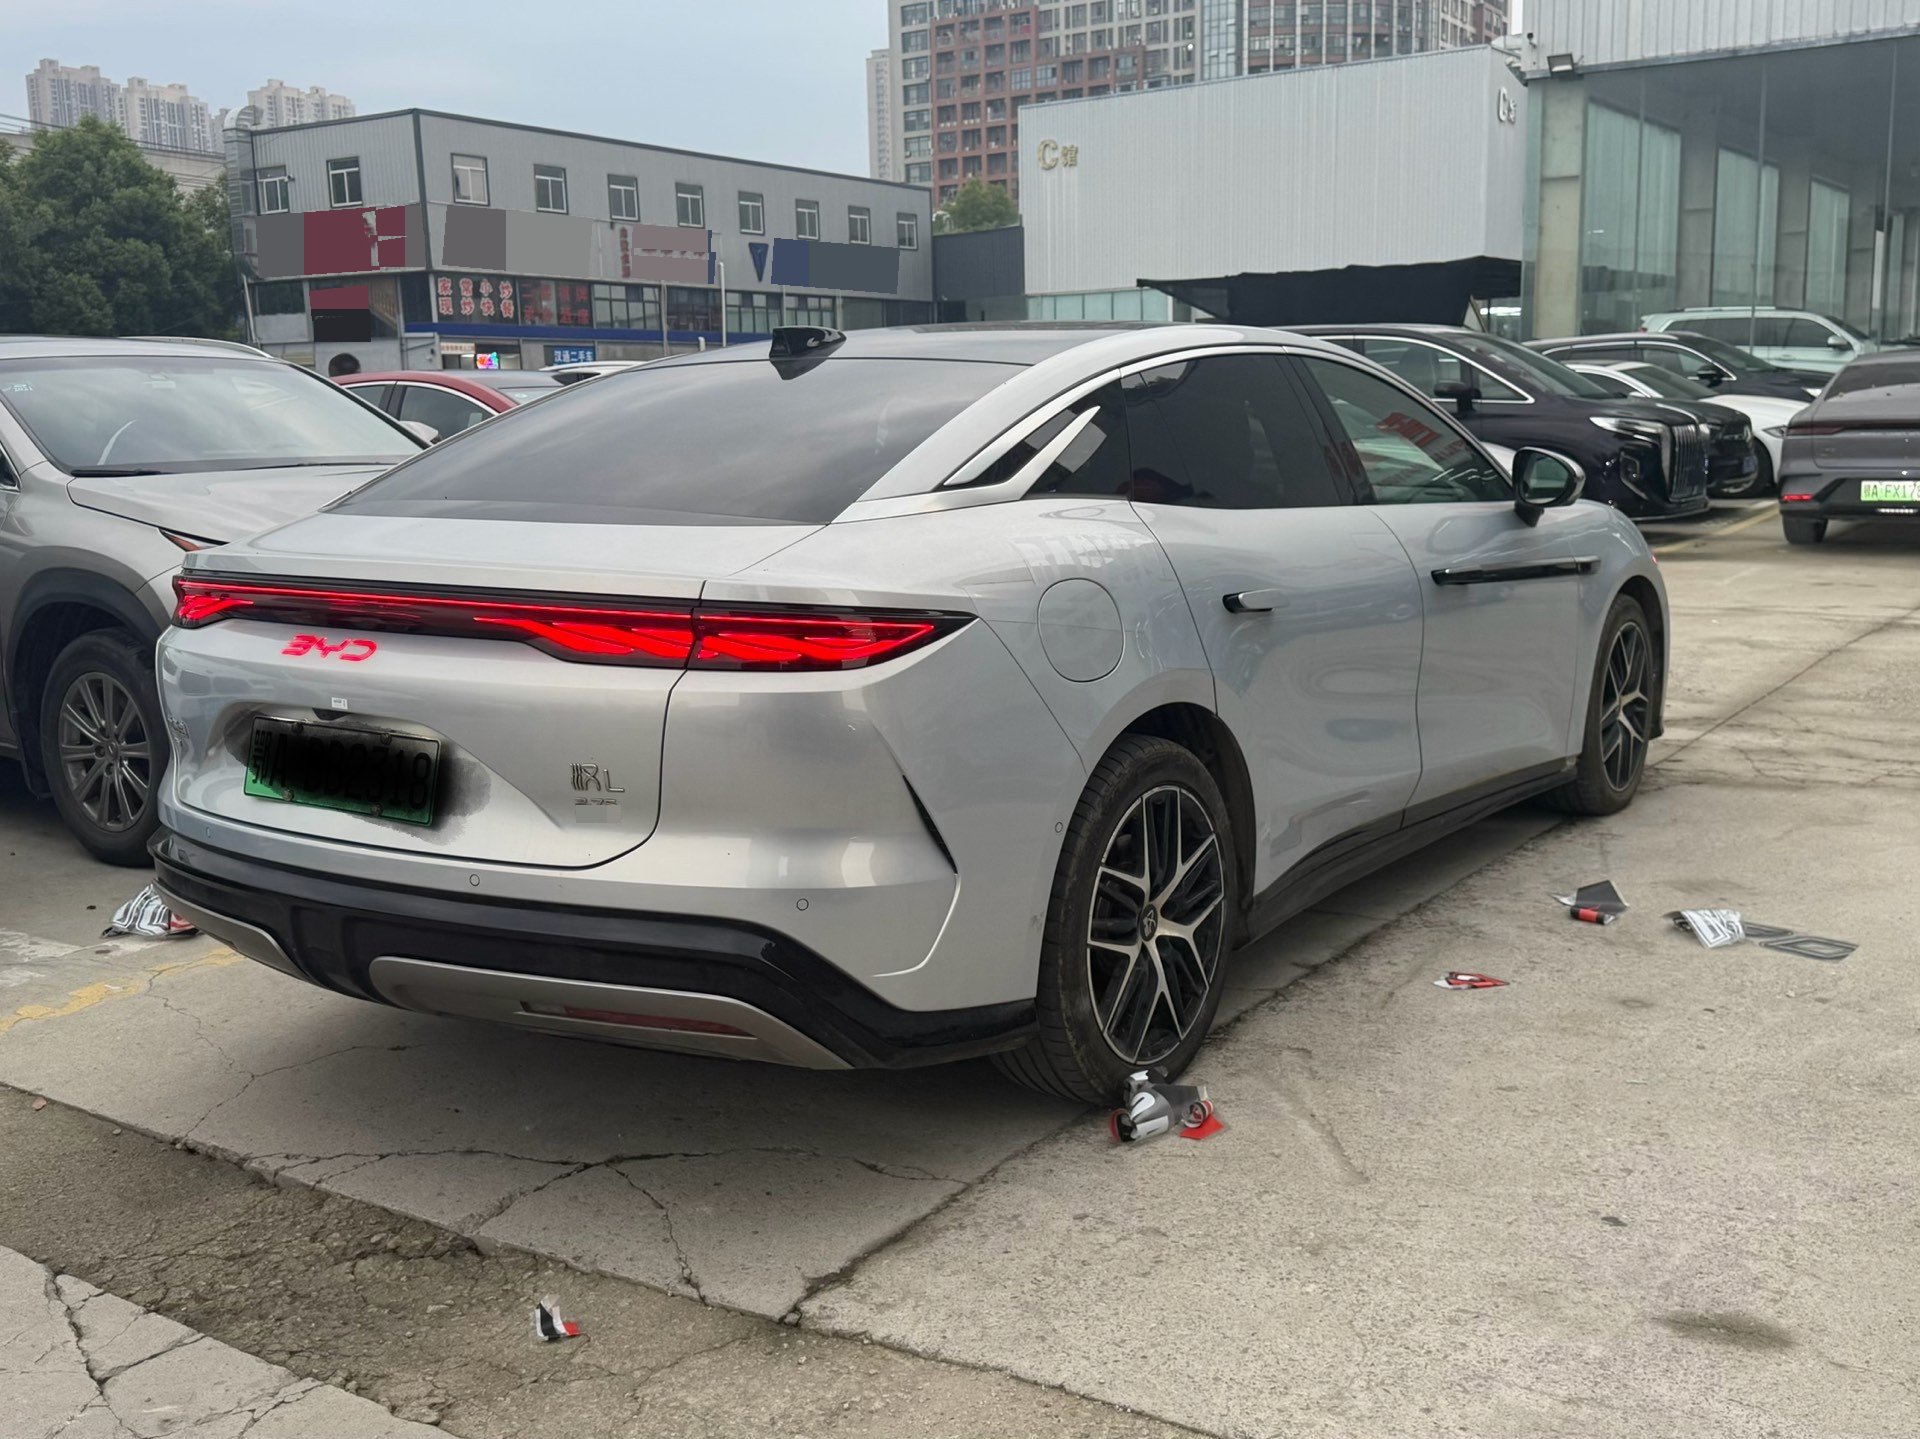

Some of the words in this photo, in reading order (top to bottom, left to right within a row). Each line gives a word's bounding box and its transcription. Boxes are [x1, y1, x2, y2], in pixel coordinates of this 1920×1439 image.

[1038, 139, 1078, 170] C馆
[437, 277, 513, 299] 家常小炒
[438, 297, 515, 319] 现炒快餐
[281, 634, 379, 662] BYD
